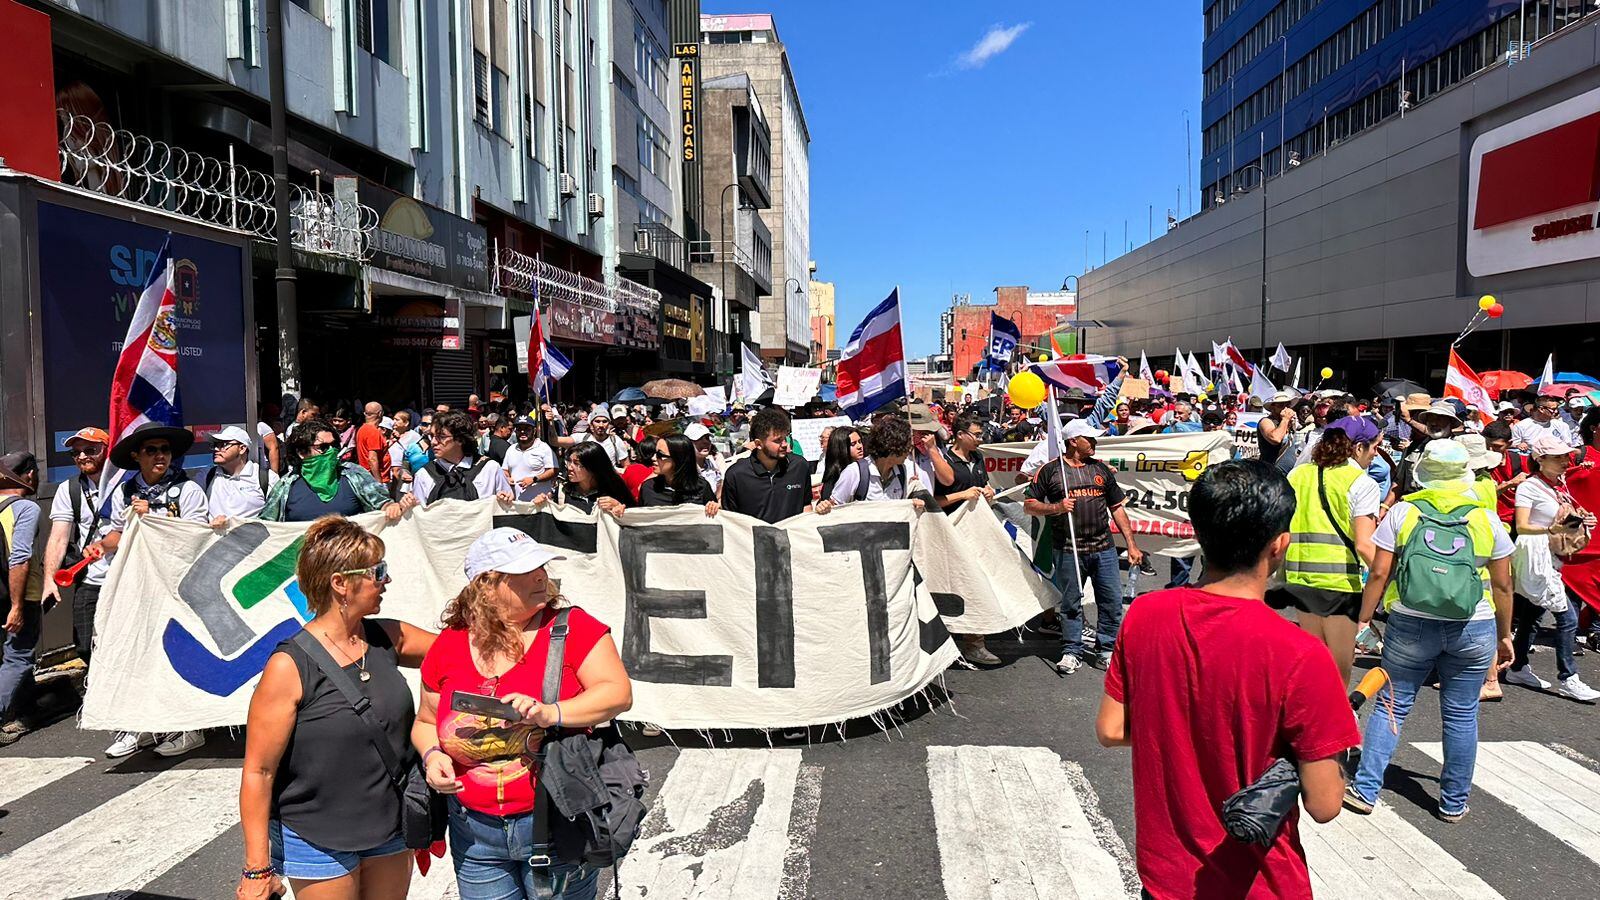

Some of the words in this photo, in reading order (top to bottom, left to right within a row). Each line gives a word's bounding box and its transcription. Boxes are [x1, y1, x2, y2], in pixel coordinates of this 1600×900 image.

[676, 45, 696, 55] LAS
[682, 63, 694, 160] AMERICAS
[382, 229, 447, 269] EMPANADOTA
[182, 346, 202, 356] USTED!
[1235, 430, 1257, 445] FUE
[1109, 458, 1129, 473] EL
